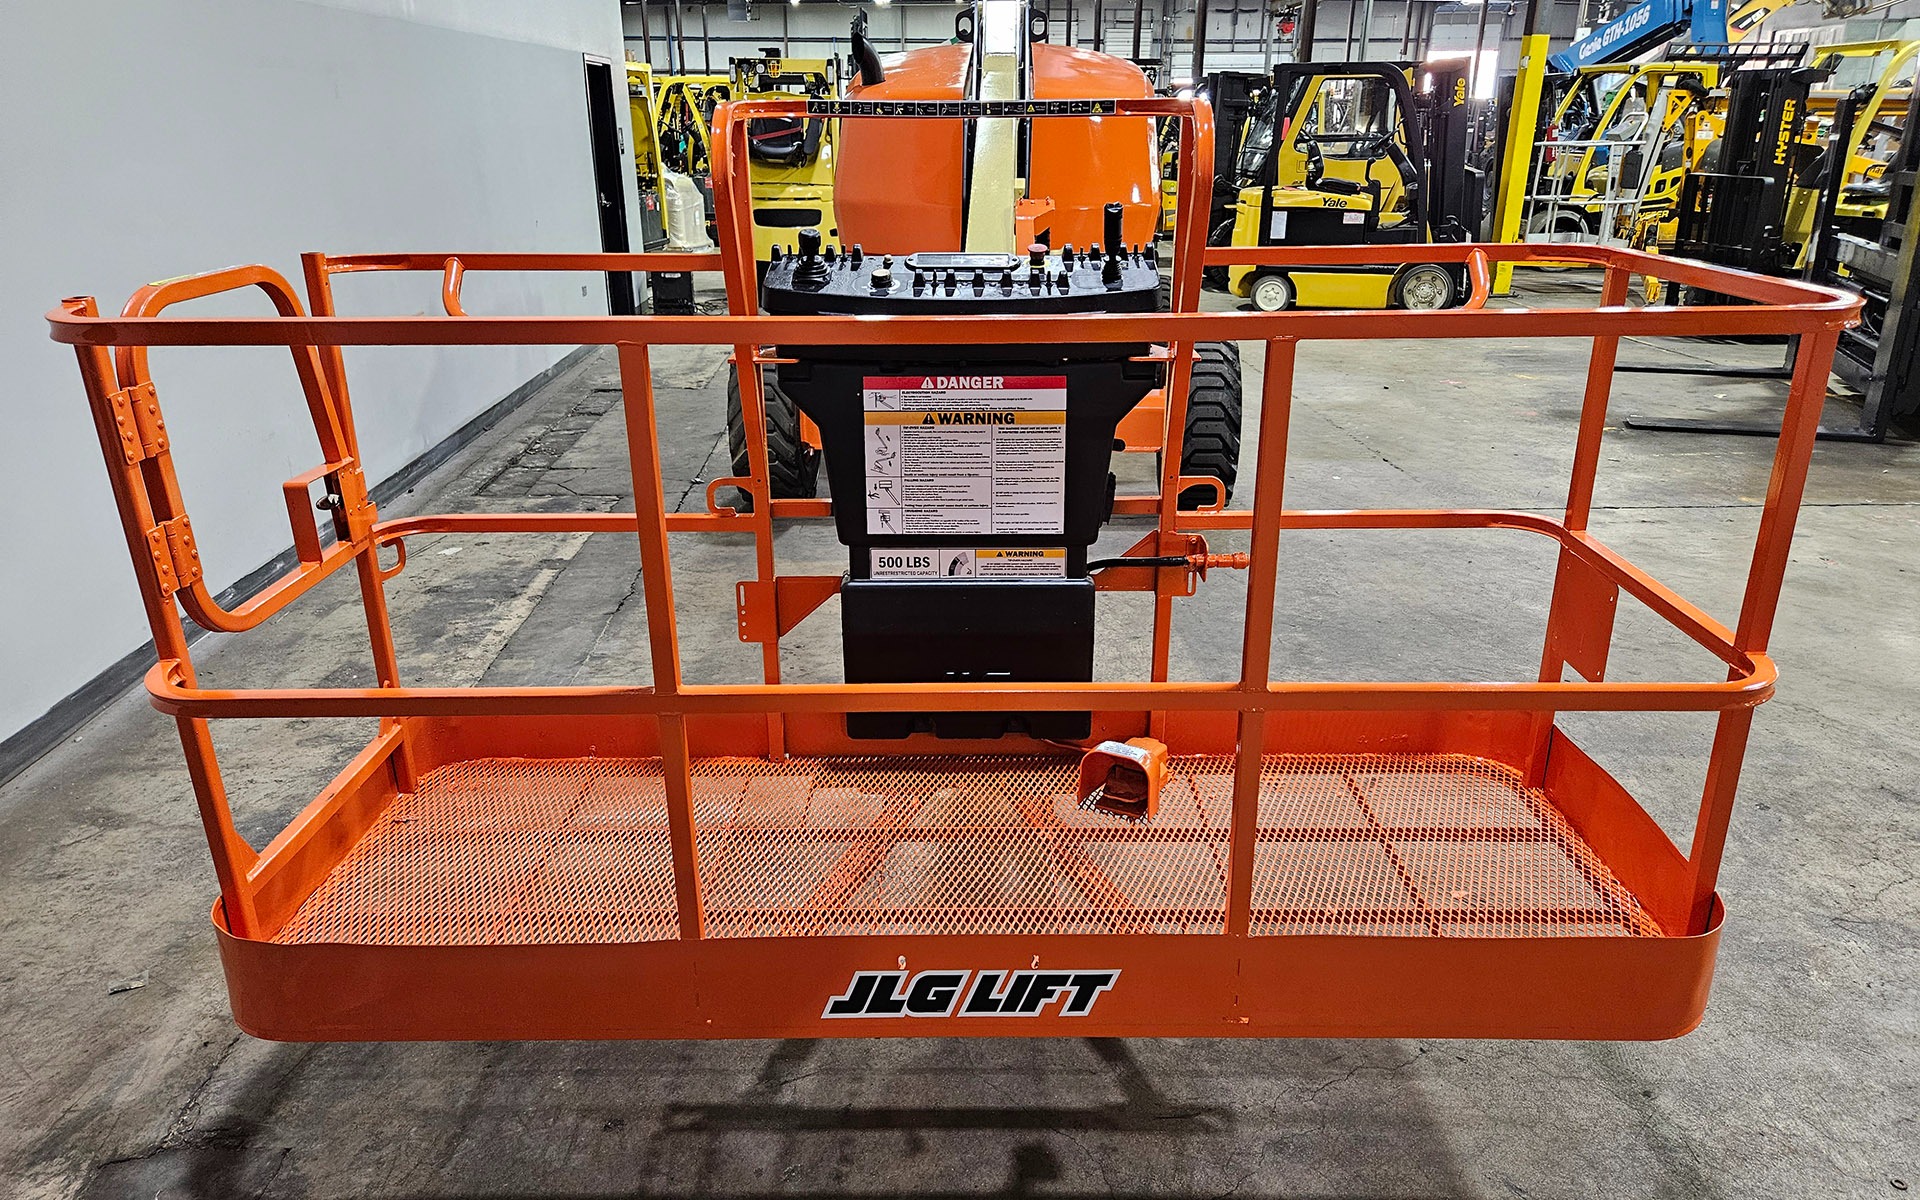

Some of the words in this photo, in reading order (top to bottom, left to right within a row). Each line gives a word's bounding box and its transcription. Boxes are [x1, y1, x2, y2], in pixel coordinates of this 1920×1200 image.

[1602, 4, 1651, 47] GTH-1056
[1453, 77, 1466, 107] Yale
[1773, 99, 1797, 165] HYSTER
[1322, 197, 1348, 208] Yale
[937, 376, 1005, 389] DANGER
[937, 413, 1015, 425] WARNING
[879, 557, 903, 568] 500
[906, 557, 931, 568] LBS
[823, 971, 971, 1018] JLG
[958, 970, 1121, 1017] LIFT
